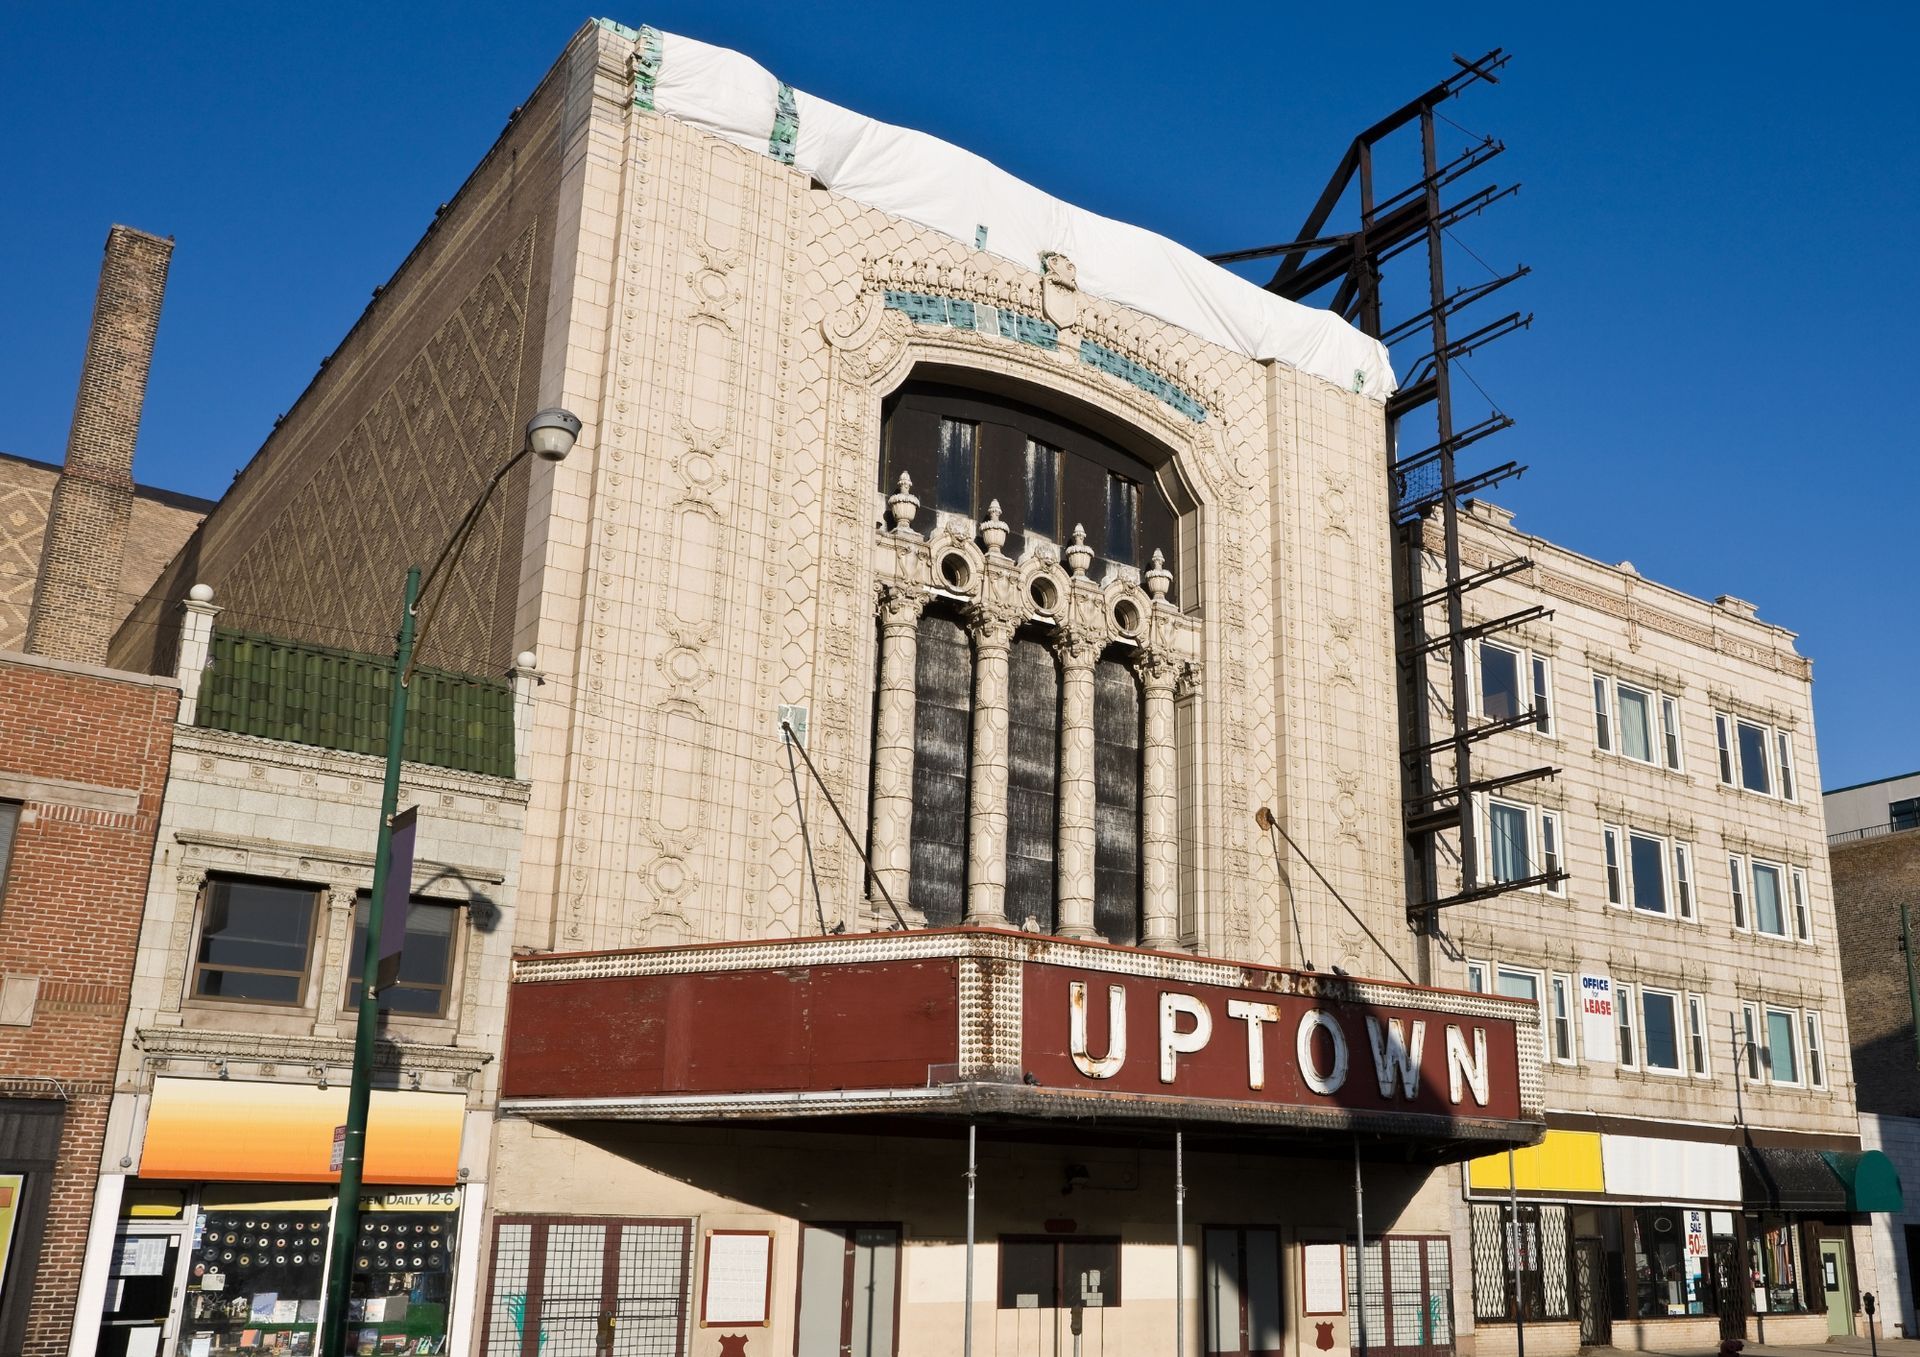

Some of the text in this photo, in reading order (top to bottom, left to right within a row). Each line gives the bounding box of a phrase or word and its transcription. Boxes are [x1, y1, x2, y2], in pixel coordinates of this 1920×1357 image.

[1583, 977, 1609, 991] OFFICE
[1584, 998, 1611, 1015] LEASE
[1070, 981, 1489, 1107] UPTOWN
[358, 1192, 454, 1206] PEN DAILY 12-6
[1691, 1211, 1700, 1221] BIG
[1690, 1222, 1701, 1232] SALE
